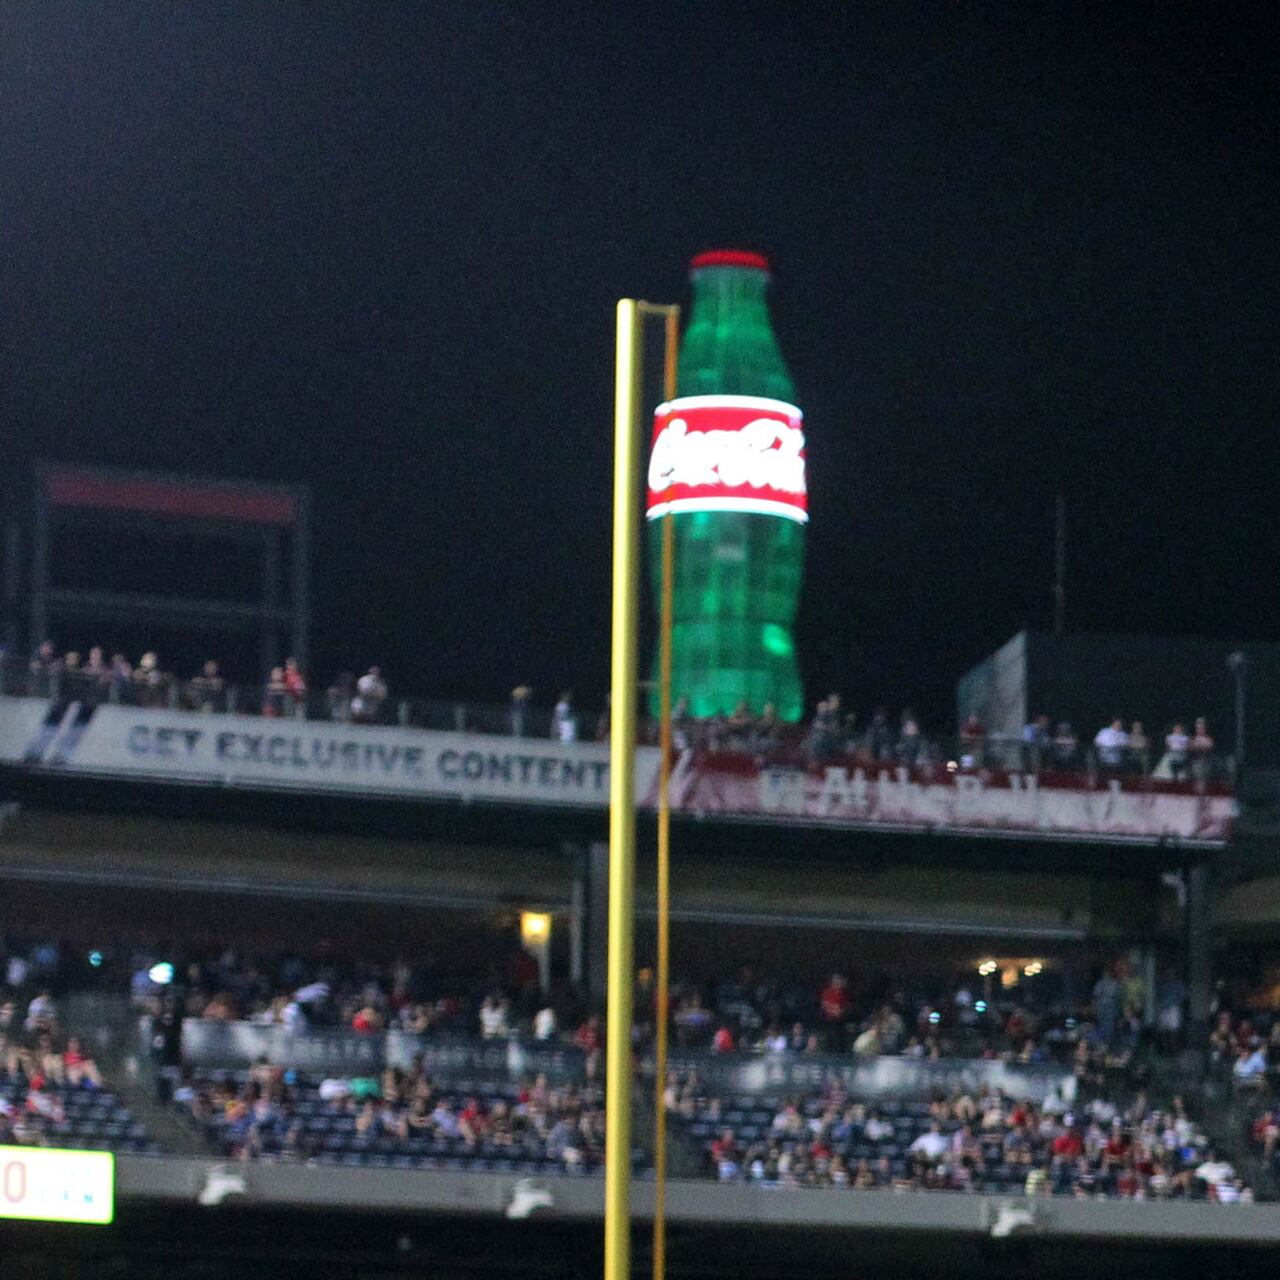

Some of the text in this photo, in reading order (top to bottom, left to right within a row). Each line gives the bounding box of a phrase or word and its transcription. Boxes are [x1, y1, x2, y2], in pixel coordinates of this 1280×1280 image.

[127, 724, 612, 790] GET EXCLUSIVE CONTENT
